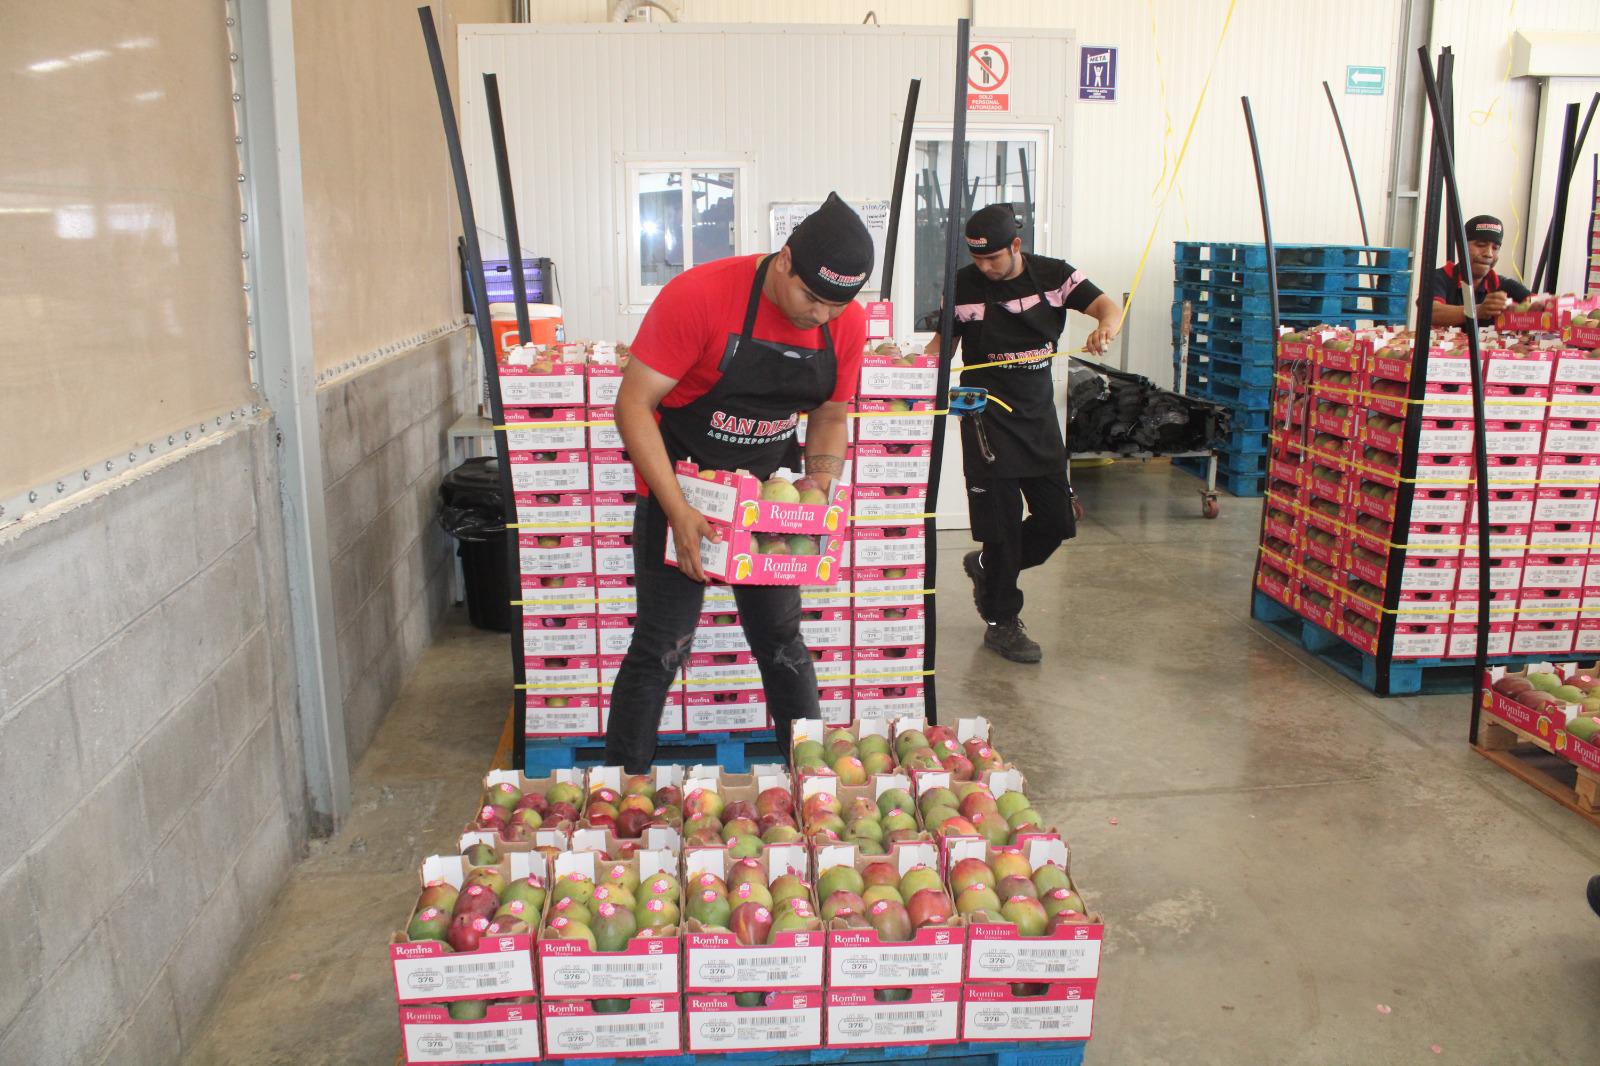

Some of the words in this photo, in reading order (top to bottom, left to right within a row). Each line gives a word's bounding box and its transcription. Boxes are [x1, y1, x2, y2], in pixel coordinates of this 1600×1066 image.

[1577, 329, 1600, 341] Romin
[863, 357, 887, 365] Romina
[1379, 359, 1400, 372] Romina
[862, 403, 885, 411] Romina
[710, 411, 756, 436] SAN
[859, 447, 882, 455] Romina
[770, 504, 815, 521] Romina
[780, 520, 803, 529] Mangos
[763, 556, 808, 573] Romina
[773, 571, 796, 581] Mangos
[1499, 698, 1530, 722] Romina
[1573, 740, 1600, 764] Romin
[975, 926, 1011, 936] Romina
[692, 935, 729, 945] Romina
[834, 934, 870, 943] Romina
[396, 944, 433, 955] Romina
[544, 943, 582, 953] Romina
[417, 975, 434, 983] 376
[563, 972, 581, 981] 376
[831, 992, 867, 1003] Romina
[968, 987, 1004, 998] Romina
[548, 1003, 585, 1014] Romina
[692, 998, 728, 1009] Romina
[406, 1011, 442, 1021] Romina
[709, 1026, 726, 1034] 376
[847, 1021, 864, 1029] 376
[427, 1040, 443, 1048] 376
[567, 1035, 584, 1043] 376
